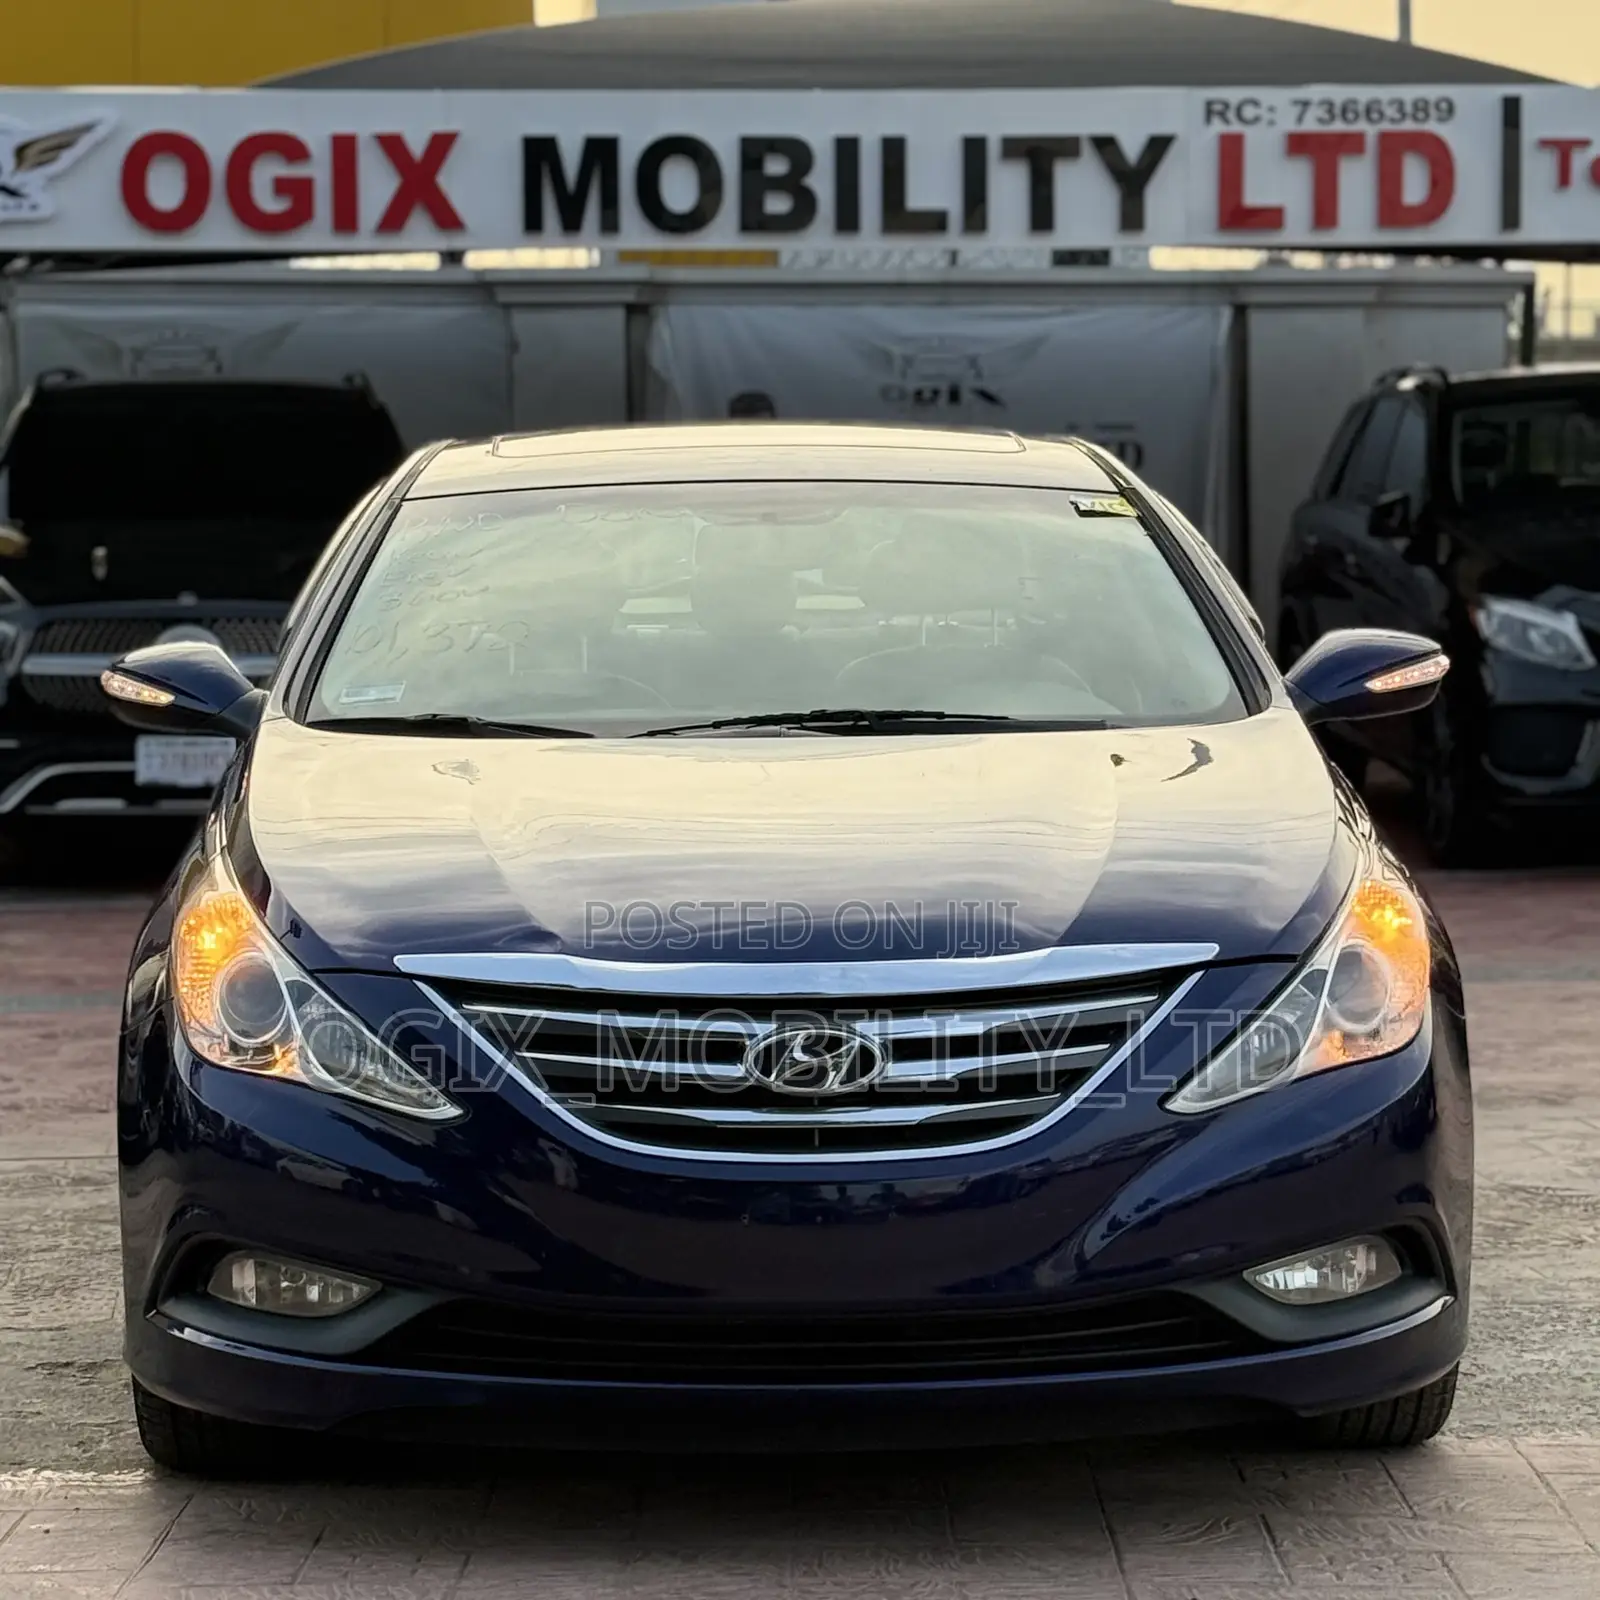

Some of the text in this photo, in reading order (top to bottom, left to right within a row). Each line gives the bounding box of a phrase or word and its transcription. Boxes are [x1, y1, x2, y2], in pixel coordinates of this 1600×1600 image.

[1203, 96, 1456, 126] RC: 7366389
[120, 130, 1456, 235] OGIX MOBILITY LTD
